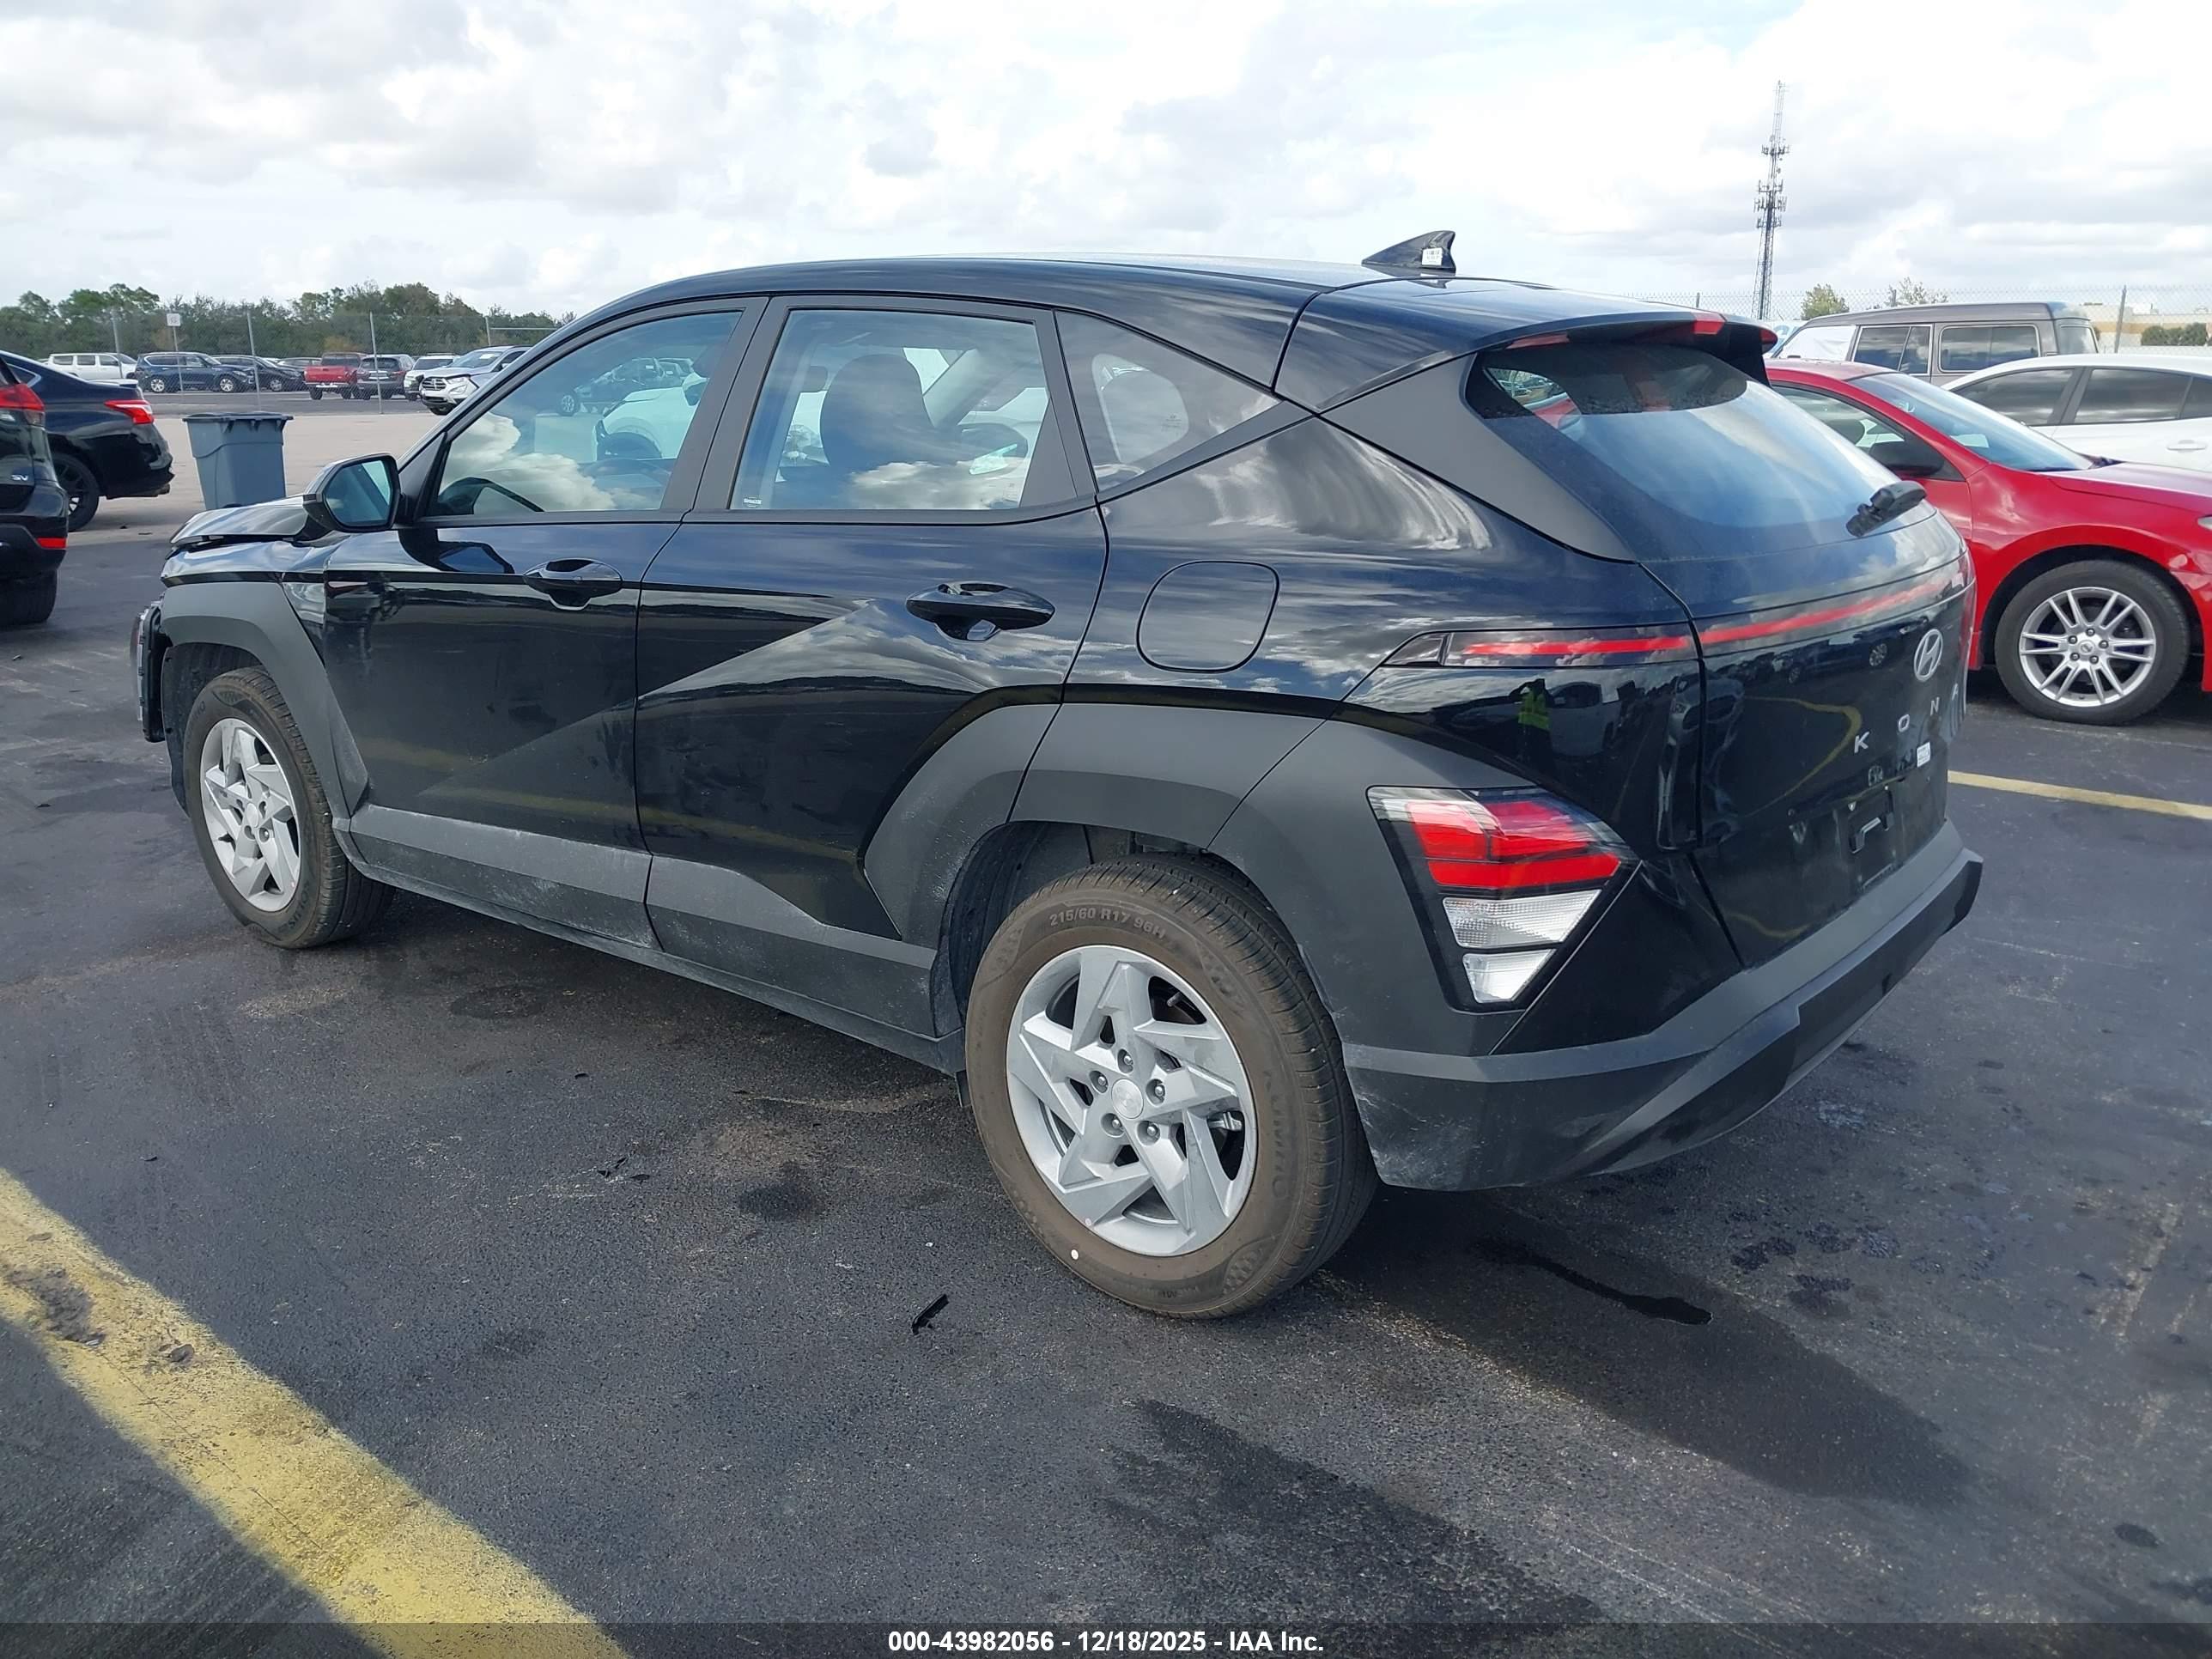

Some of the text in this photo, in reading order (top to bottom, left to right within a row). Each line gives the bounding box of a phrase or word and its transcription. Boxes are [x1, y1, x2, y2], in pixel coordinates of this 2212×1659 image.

[1854, 683, 1959, 754] KONA
[1049, 907, 1097, 927] 215/60
[1100, 908, 1131, 923] R17
